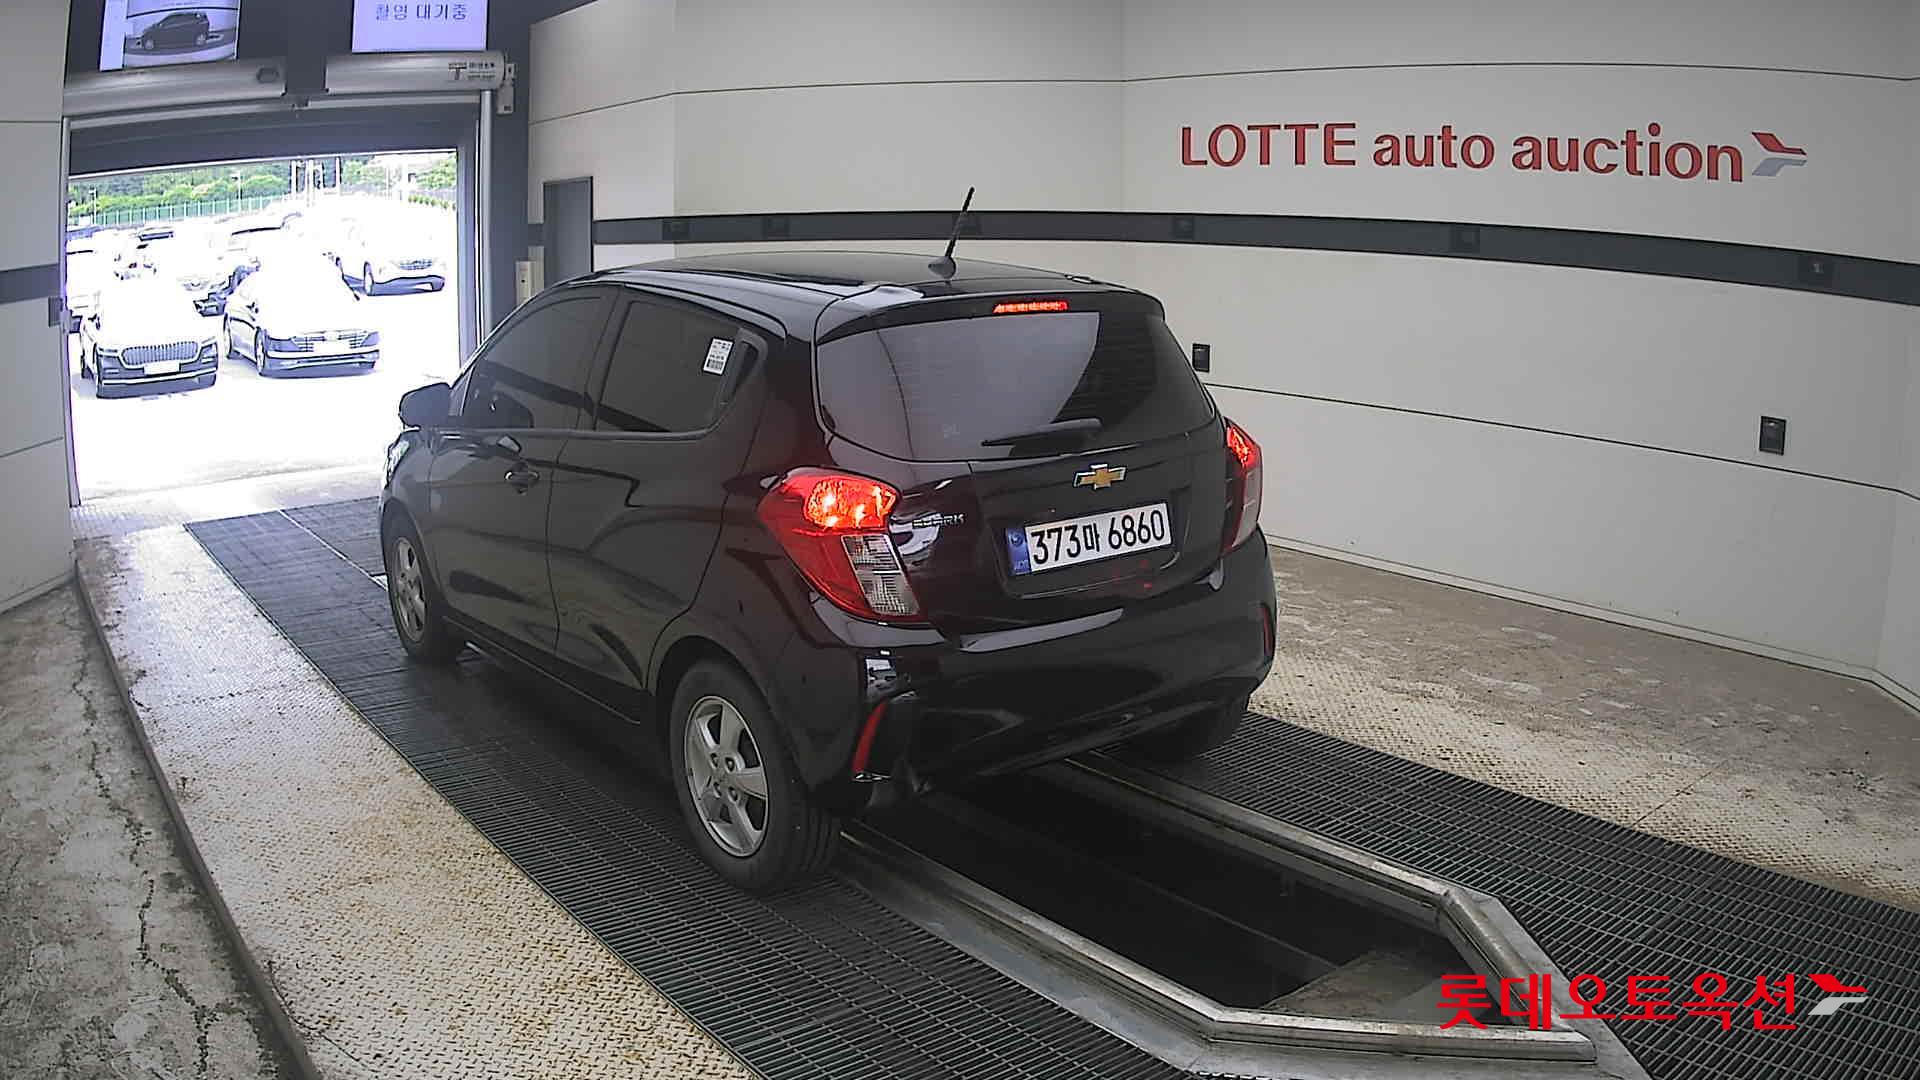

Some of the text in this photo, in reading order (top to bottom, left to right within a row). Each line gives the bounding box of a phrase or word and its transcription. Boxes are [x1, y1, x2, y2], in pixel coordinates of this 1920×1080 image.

[416, 4, 467, 20] 대기중
[1181, 122, 1744, 182] LOTTE auto auction
[1031, 509, 1165, 565] 373마 6860
